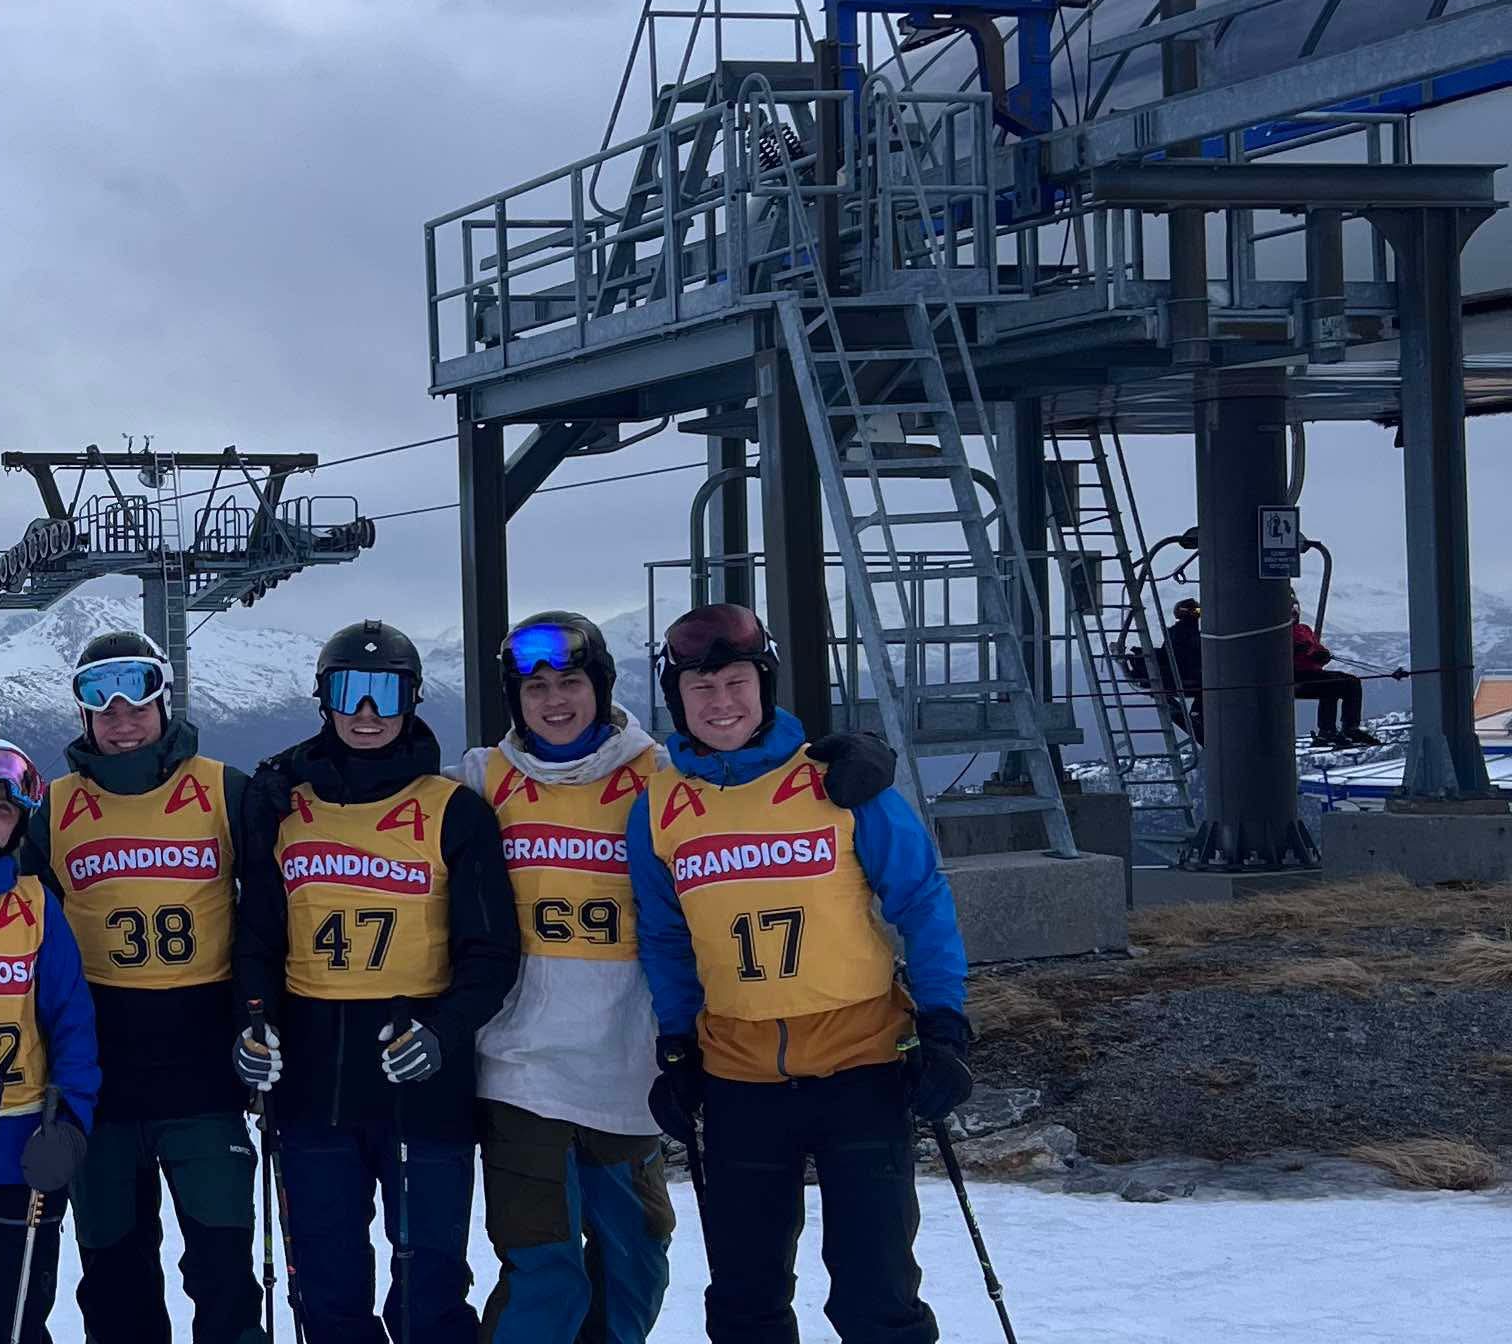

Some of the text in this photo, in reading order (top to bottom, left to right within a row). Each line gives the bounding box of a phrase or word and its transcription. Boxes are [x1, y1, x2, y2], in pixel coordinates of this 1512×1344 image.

[71, 847, 218, 880] GRANDIOSA
[284, 854, 426, 884] GRANDIOSA
[503, 838, 629, 862] GRANDIOS
[676, 838, 832, 881] GRANDIOSA
[106, 904, 196, 968] 38
[313, 908, 397, 971] 47
[533, 897, 621, 944] 69
[731, 906, 805, 981] 17
